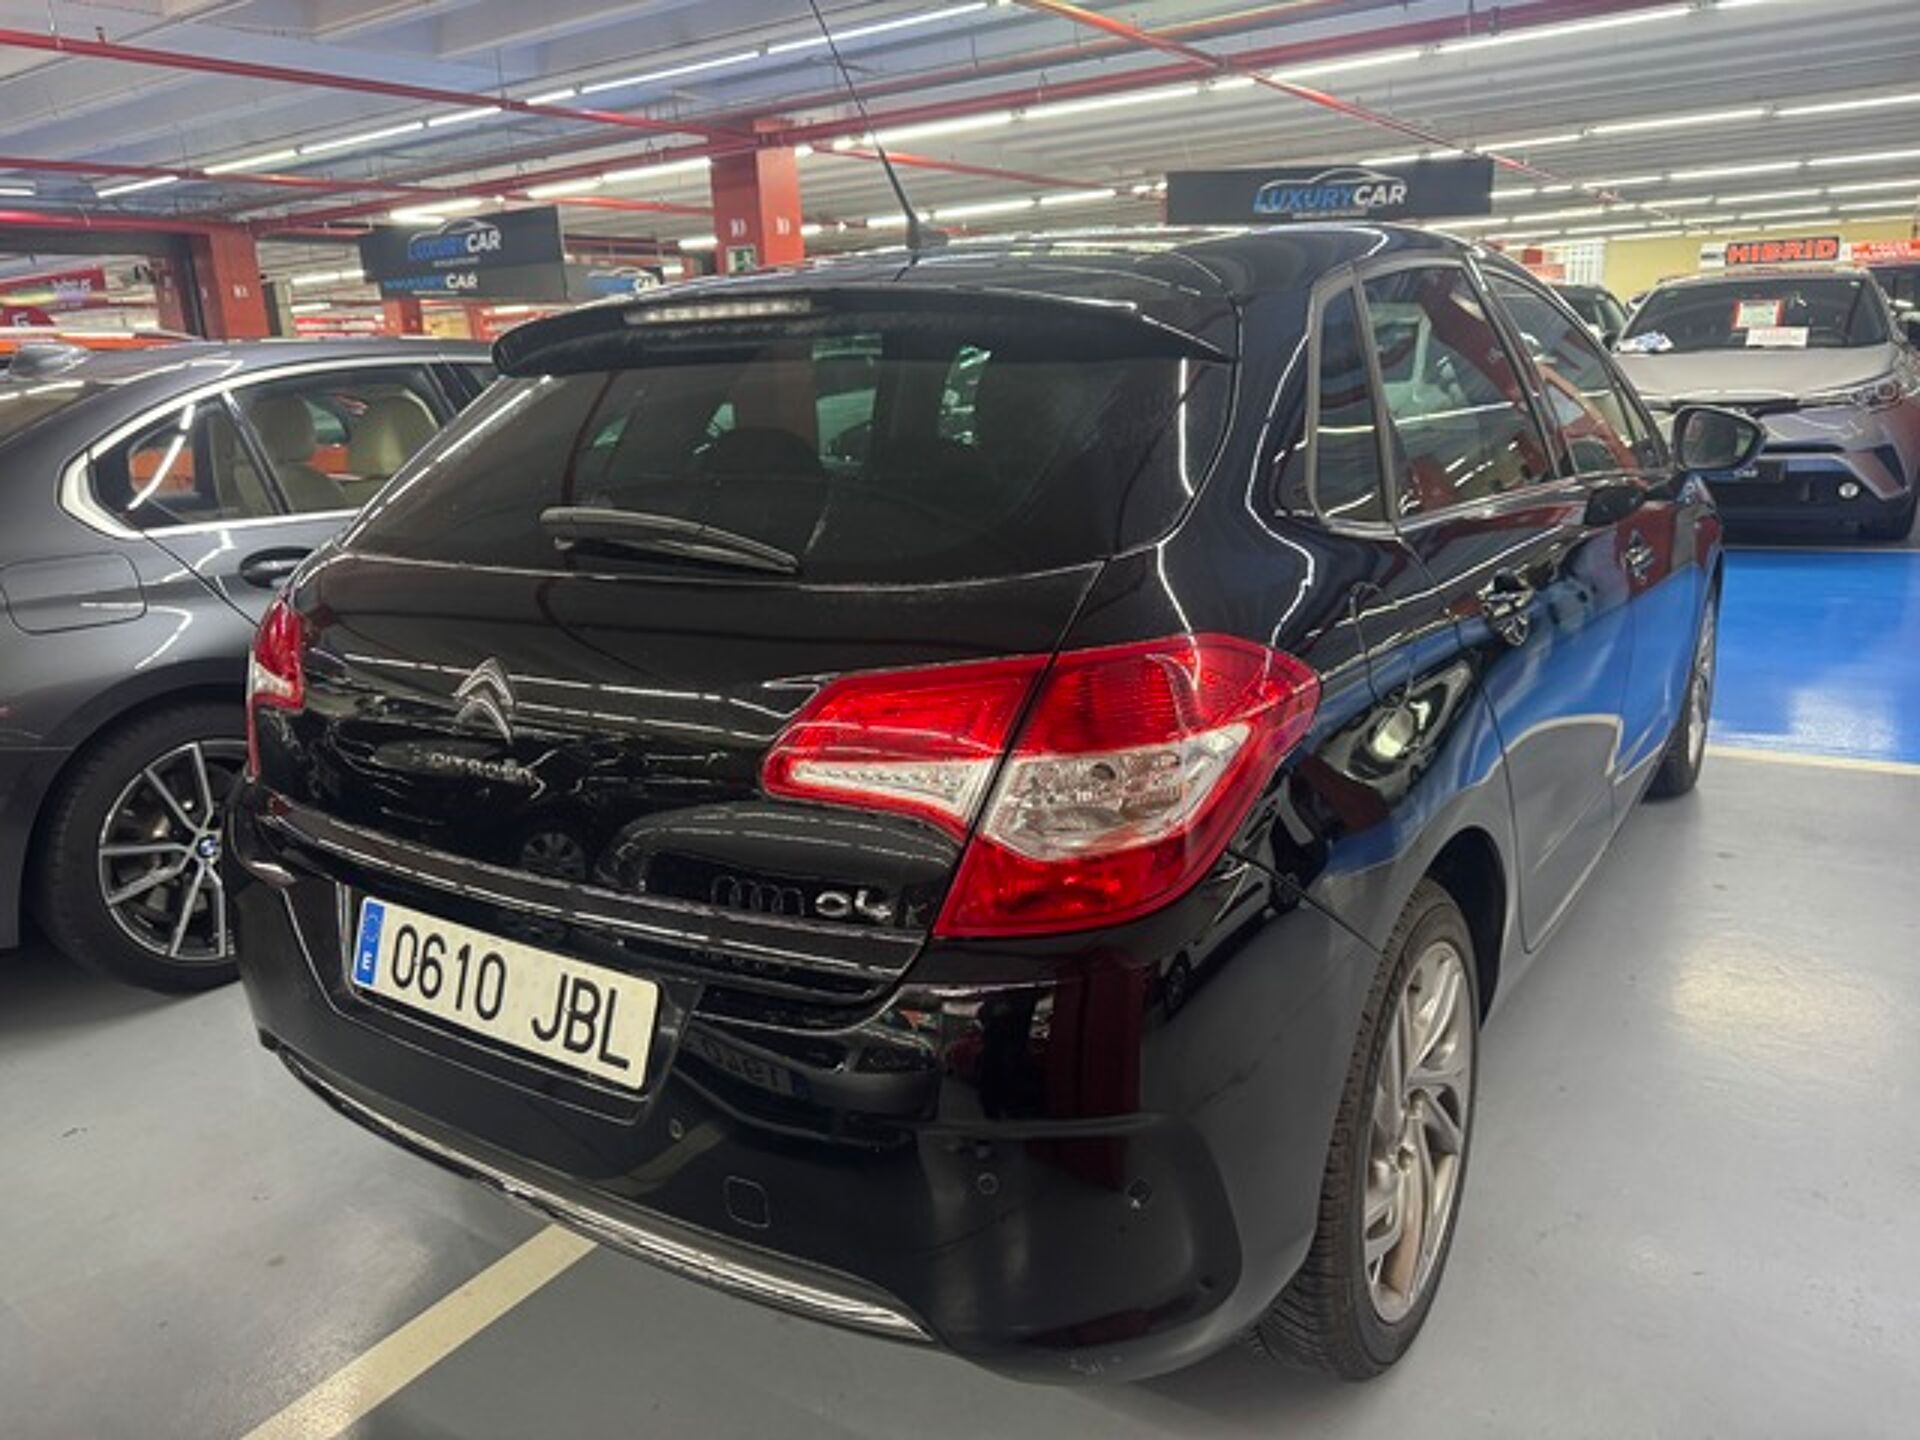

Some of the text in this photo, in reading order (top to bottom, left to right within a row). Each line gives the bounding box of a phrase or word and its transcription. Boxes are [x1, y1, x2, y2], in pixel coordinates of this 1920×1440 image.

[1253, 184, 1407, 214] LUXURYCAR
[408, 230, 501, 263] LUCAR
[1727, 239, 1838, 263] HIBRID
[361, 951, 373, 971] E
[391, 923, 508, 1021] 0610
[530, 972, 630, 1070] JBL
